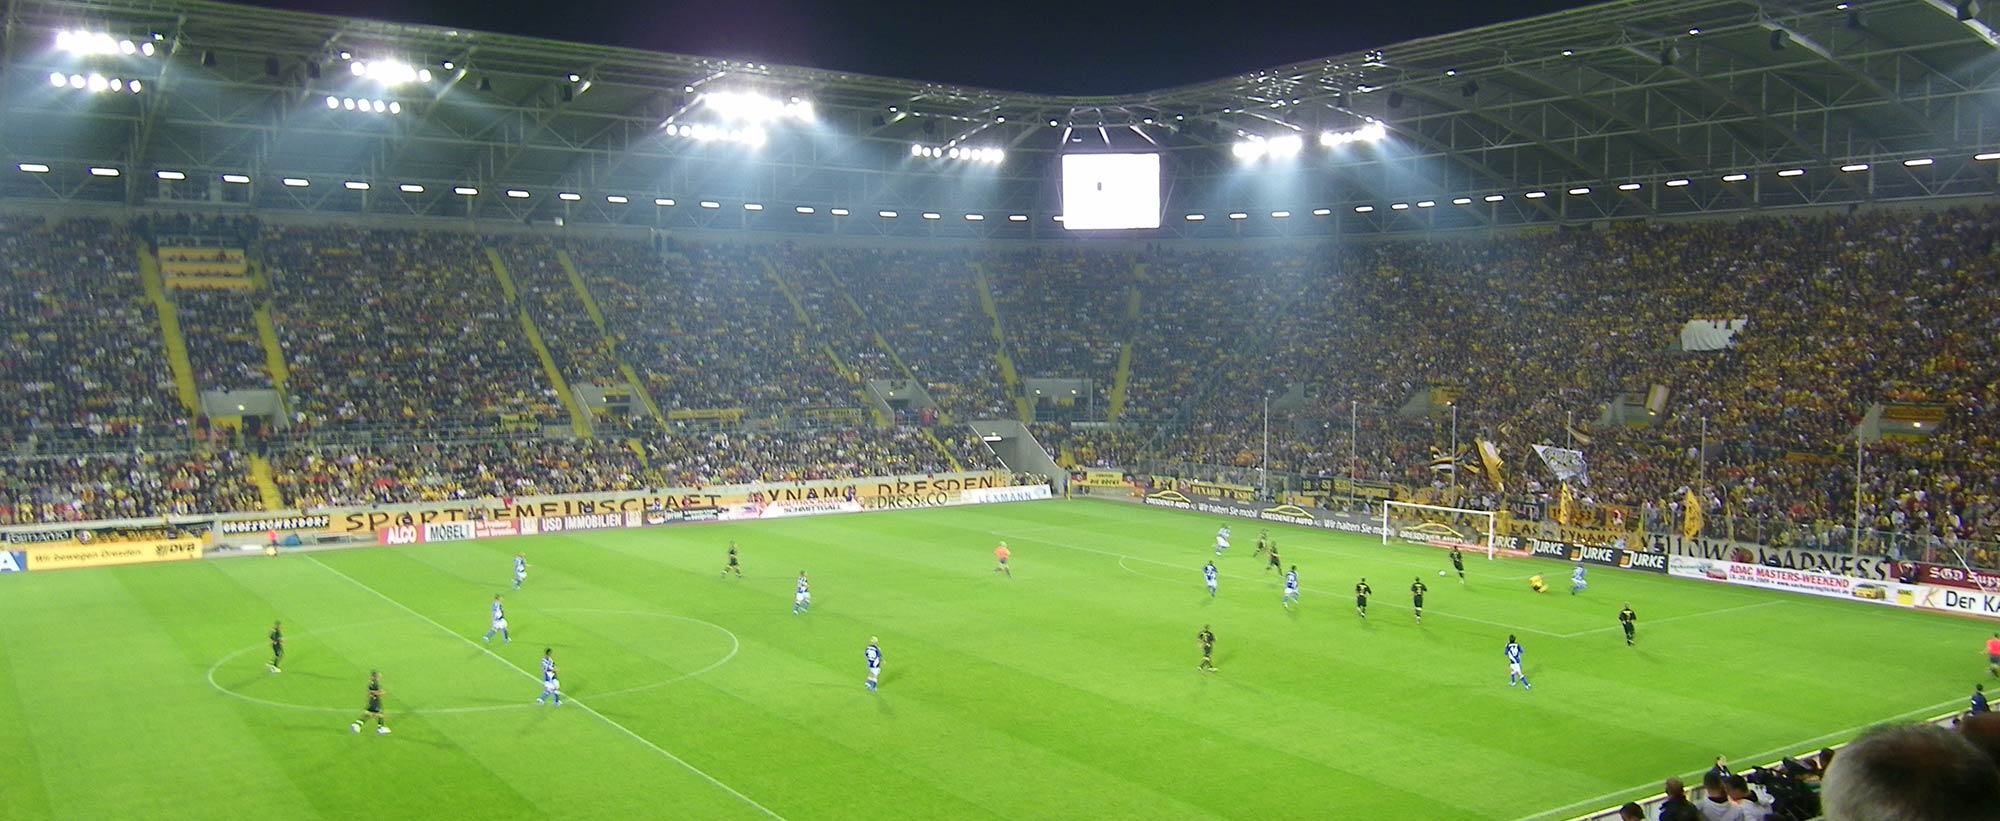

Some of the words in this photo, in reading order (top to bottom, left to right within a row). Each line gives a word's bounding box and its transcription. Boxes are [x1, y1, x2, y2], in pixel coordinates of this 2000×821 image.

[878, 476, 992, 495] DRESDEN
[542, 517, 562, 532] USD
[565, 513, 622, 530] IMMOBILIEN
[1324, 519, 1336, 529] Wir
[1336, 521, 1360, 532] halten
[1360, 523, 1372, 534] Sie
[430, 524, 465, 541] MÖBEL
[1527, 538, 1564, 556] JURKE
[1571, 543, 1613, 562] JURKE
[1622, 549, 1666, 569] JURKE
[1730, 565, 1754, 575] ADAC
[1756, 567, 1849, 588] MASTERS-WEEKEND
[1929, 566, 1963, 581] SGD
[1946, 590, 1976, 609] Der
